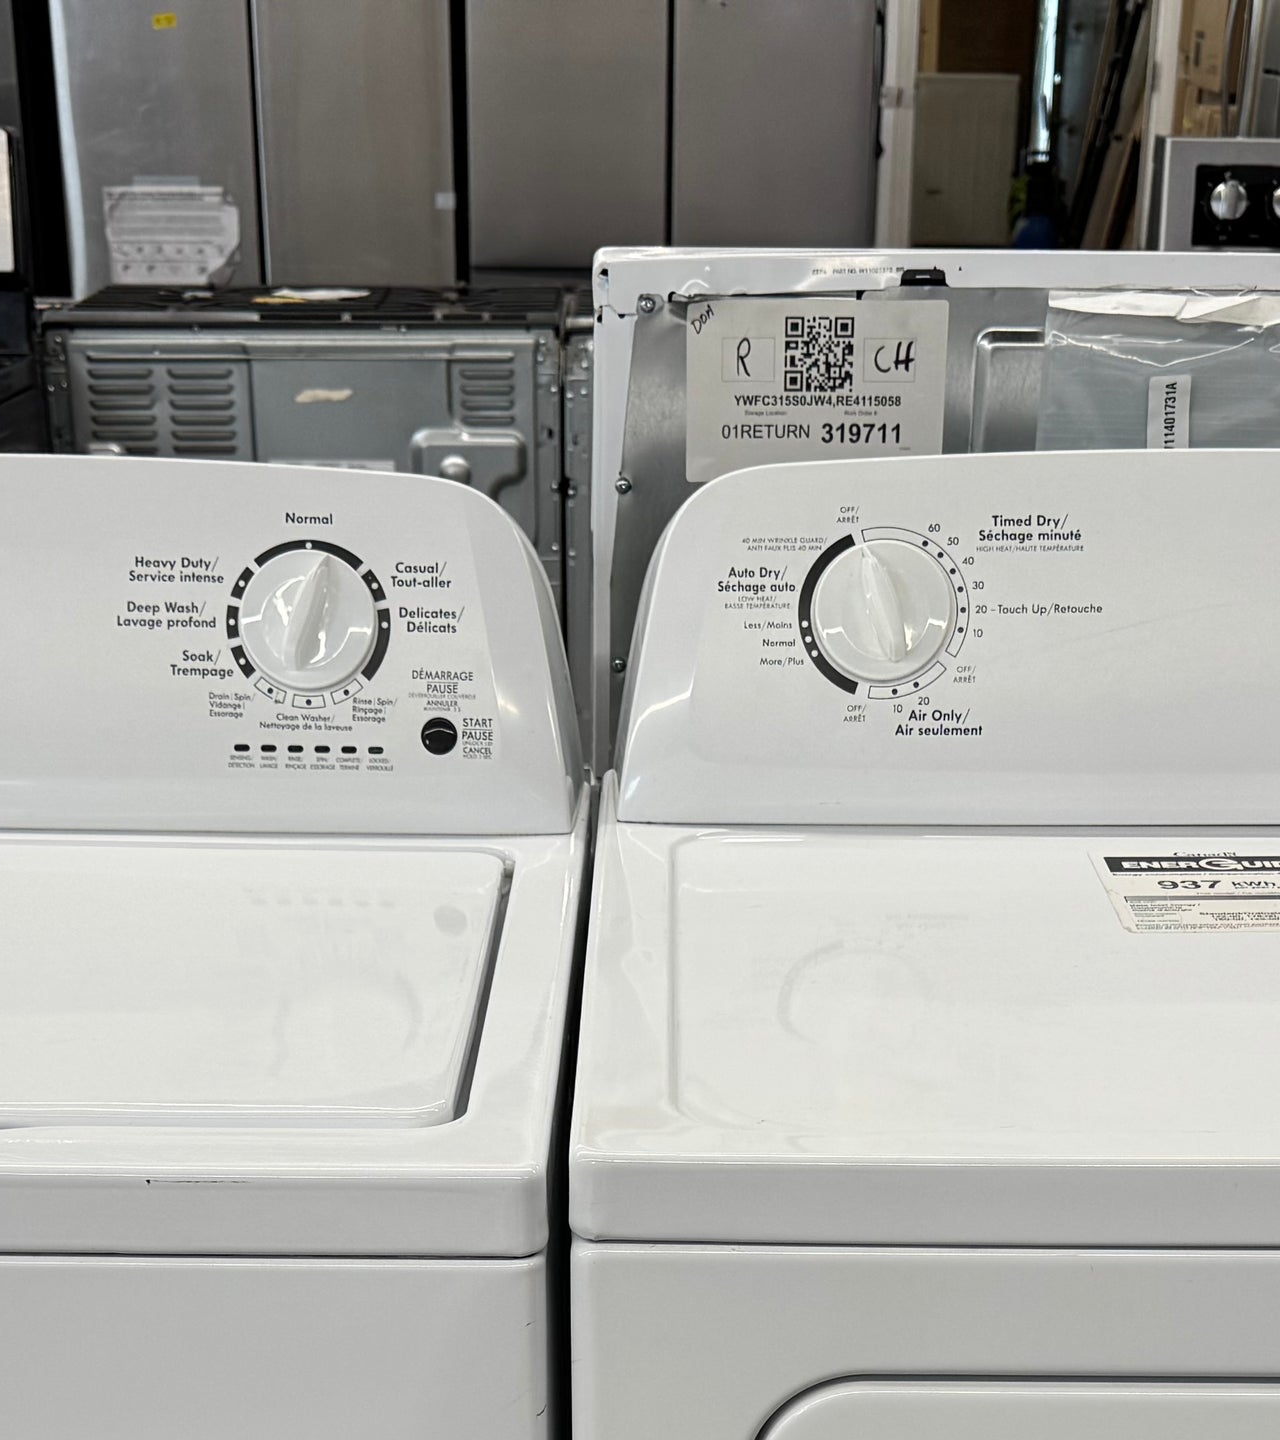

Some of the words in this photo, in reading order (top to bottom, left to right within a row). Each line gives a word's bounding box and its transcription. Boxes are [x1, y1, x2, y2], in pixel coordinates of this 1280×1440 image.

[736, 337, 751, 377] R
[1163, 381, 1178, 449] 11401731A
[721, 424, 810, 440] 01RETURN
[820, 423, 901, 444] 319711
[285, 512, 333, 525] Normal
[991, 515, 1032, 528] Timed
[1037, 514, 1069, 530] Dry/
[928, 524, 941, 533] 60
[947, 536, 960, 546] 50
[978, 529, 1033, 543] Séchage
[1038, 529, 1082, 542] minuté
[134, 556, 176, 571] Heavy
[181, 556, 219, 573] Duty/
[961, 556, 975, 566] 40
[395, 561, 447, 577] Casual/
[728, 566, 755, 579] Auto
[759, 565, 788, 582] Dry/
[128, 570, 175, 583] Service
[179, 571, 224, 584] intense
[391, 576, 452, 589] Tout-aller
[717, 580, 766, 595] Séchage
[770, 581, 796, 593] auto
[972, 581, 985, 590] 30
[127, 601, 160, 615] Deep
[165, 601, 206, 617] Wash/
[398, 606, 465, 623] Delicates/
[975, 604, 988, 614] 20
[998, 604, 1028, 615] Touch
[117, 616, 162, 630] Lavage
[167, 616, 217, 630] profond
[406, 621, 457, 634] Délicats
[743, 620, 792, 631] Less/Moins
[972, 628, 984, 638] 10
[762, 638, 796, 648] Normal
[182, 649, 221, 666] Soak/
[760, 656, 804, 667] More/Plus
[170, 664, 234, 679] Trempage
[411, 667, 474, 682] DÉMARRAGE
[956, 664, 976, 676] OFF/
[426, 683, 459, 695] PAUSE
[917, 696, 930, 706] 20
[892, 704, 903, 714] 10
[276, 713, 299, 722] Clean
[301, 714, 335, 724] Washer/
[908, 709, 928, 722] Air
[931, 707, 970, 725] Only/
[259, 722, 300, 731] Nettoyage
[324, 724, 353, 732] laveuse
[462, 718, 493, 729] START
[895, 724, 914, 736] Air
[918, 724, 983, 736] seulement
[461, 731, 494, 742] PAUSE
[1157, 879, 1222, 890] 937
[1231, 880, 1276, 888] kWh
